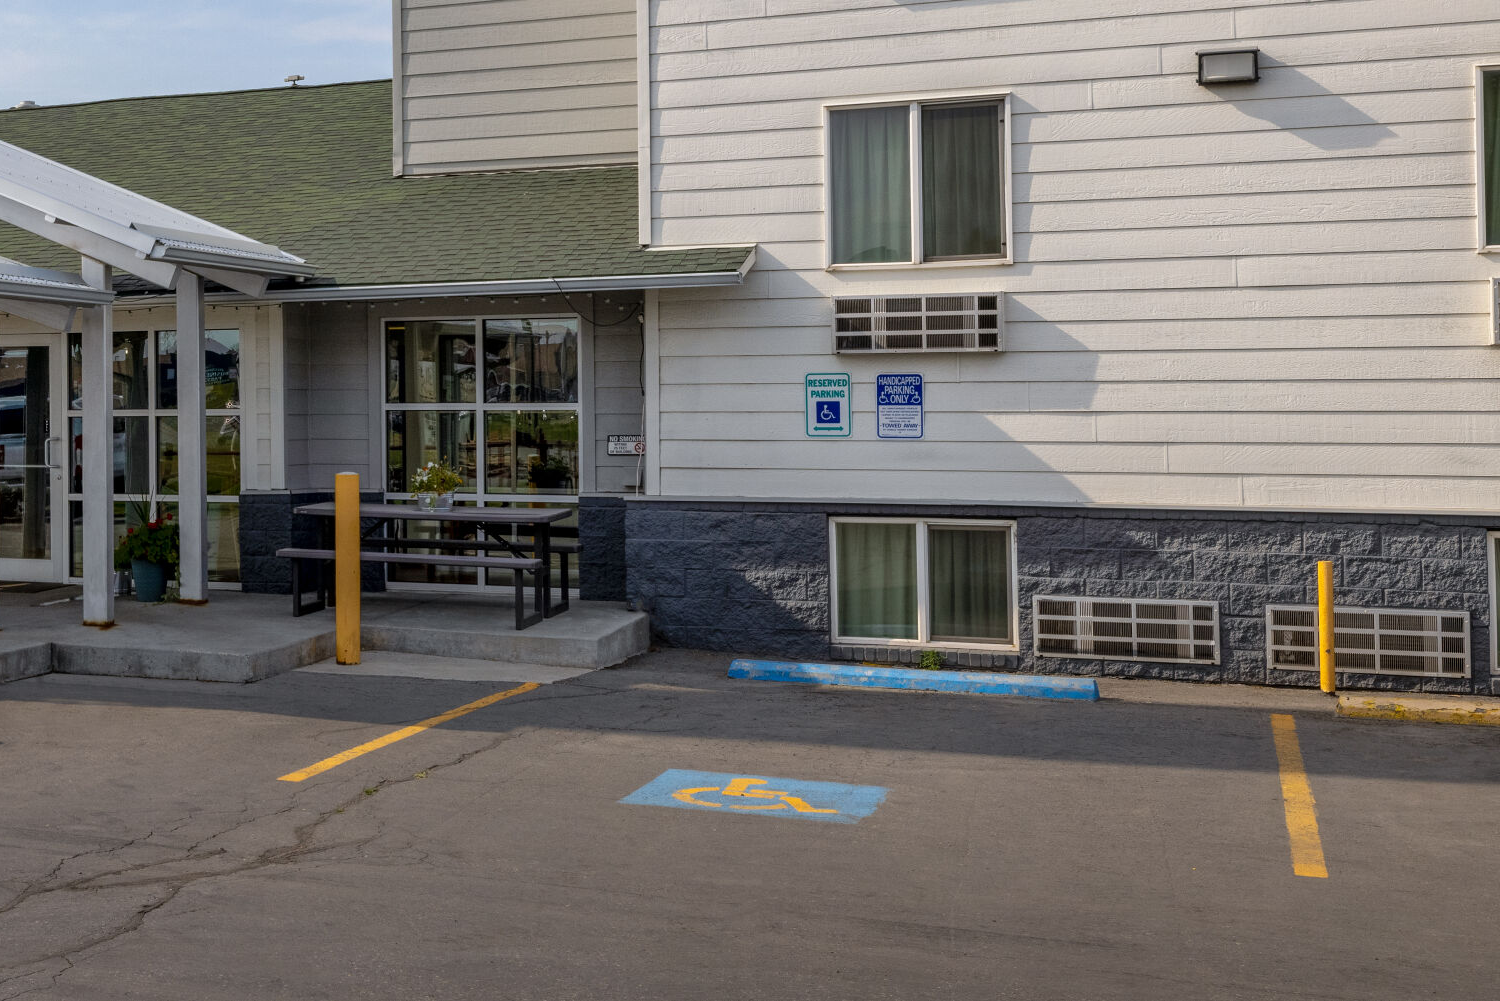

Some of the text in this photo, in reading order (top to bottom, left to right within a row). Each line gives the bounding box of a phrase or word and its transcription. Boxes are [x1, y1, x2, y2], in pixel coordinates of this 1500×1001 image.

[808, 379, 847, 387] RESERVED
[878, 376, 920, 385] HANDICAPPED
[811, 390, 845, 398] PARKING
[884, 386, 915, 394] PARKING
[890, 395, 909, 403] ONLY
